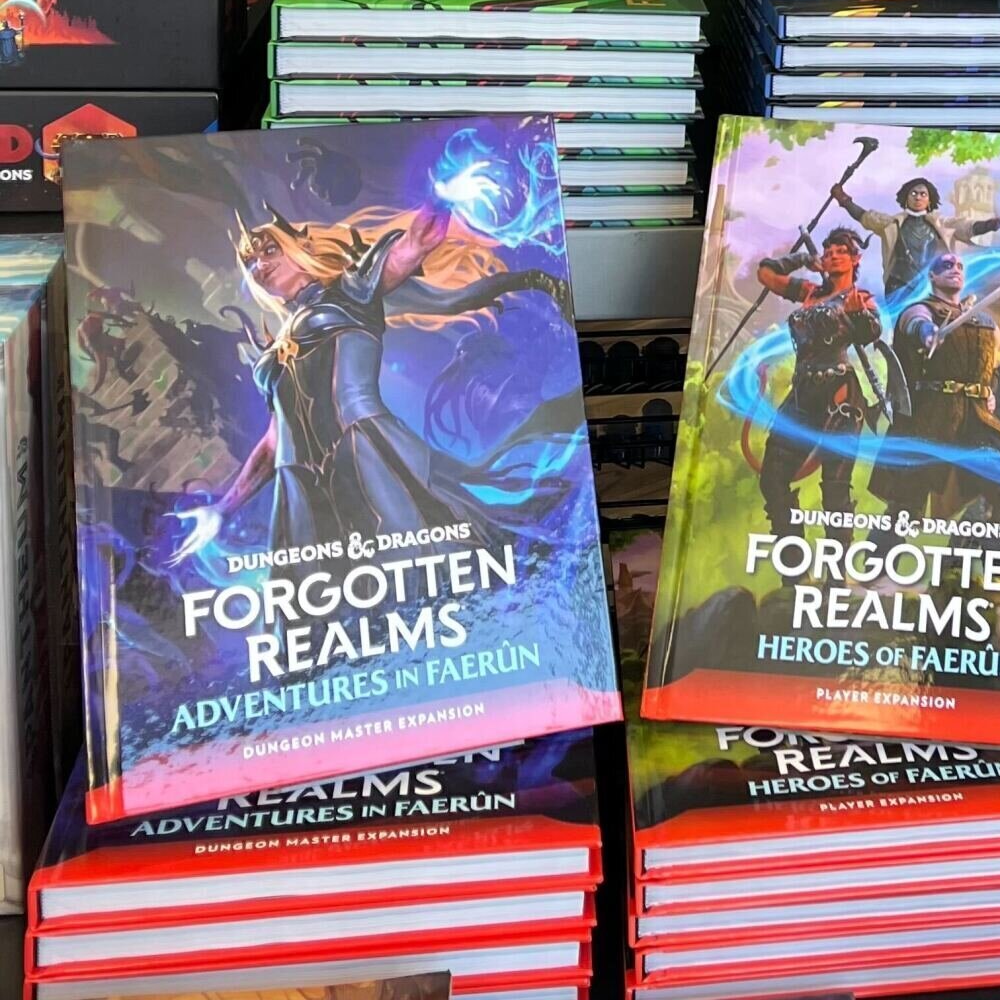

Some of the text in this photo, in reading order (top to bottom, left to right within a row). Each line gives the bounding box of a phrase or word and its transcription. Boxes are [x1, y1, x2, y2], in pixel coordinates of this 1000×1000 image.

[790, 508, 891, 533] DUNGEONS
[227, 542, 344, 574] DUNGEONS
[376, 523, 472, 553] DRAGONS
[183, 545, 517, 638] FORGOTTEN
[791, 584, 993, 644] REALMS
[246, 604, 468, 683] REALMS
[756, 634, 870, 668] HEROES
[875, 645, 906, 667] OF
[171, 667, 390, 734] ADVENTURES
[395, 667, 420, 690] IN
[816, 687, 956, 709] PLAYER EXPANSION
[242, 703, 486, 760] DUNGEON MASTER EXPANSION
[748, 773, 866, 798] HEROES
[871, 771, 900, 785] OF
[819, 792, 964, 812] PLAYER EXPANSION
[130, 803, 354, 838] ADVENTURES
[361, 803, 387, 818] IN
[194, 826, 451, 855] DUNGEON MASTER EXPANSION
